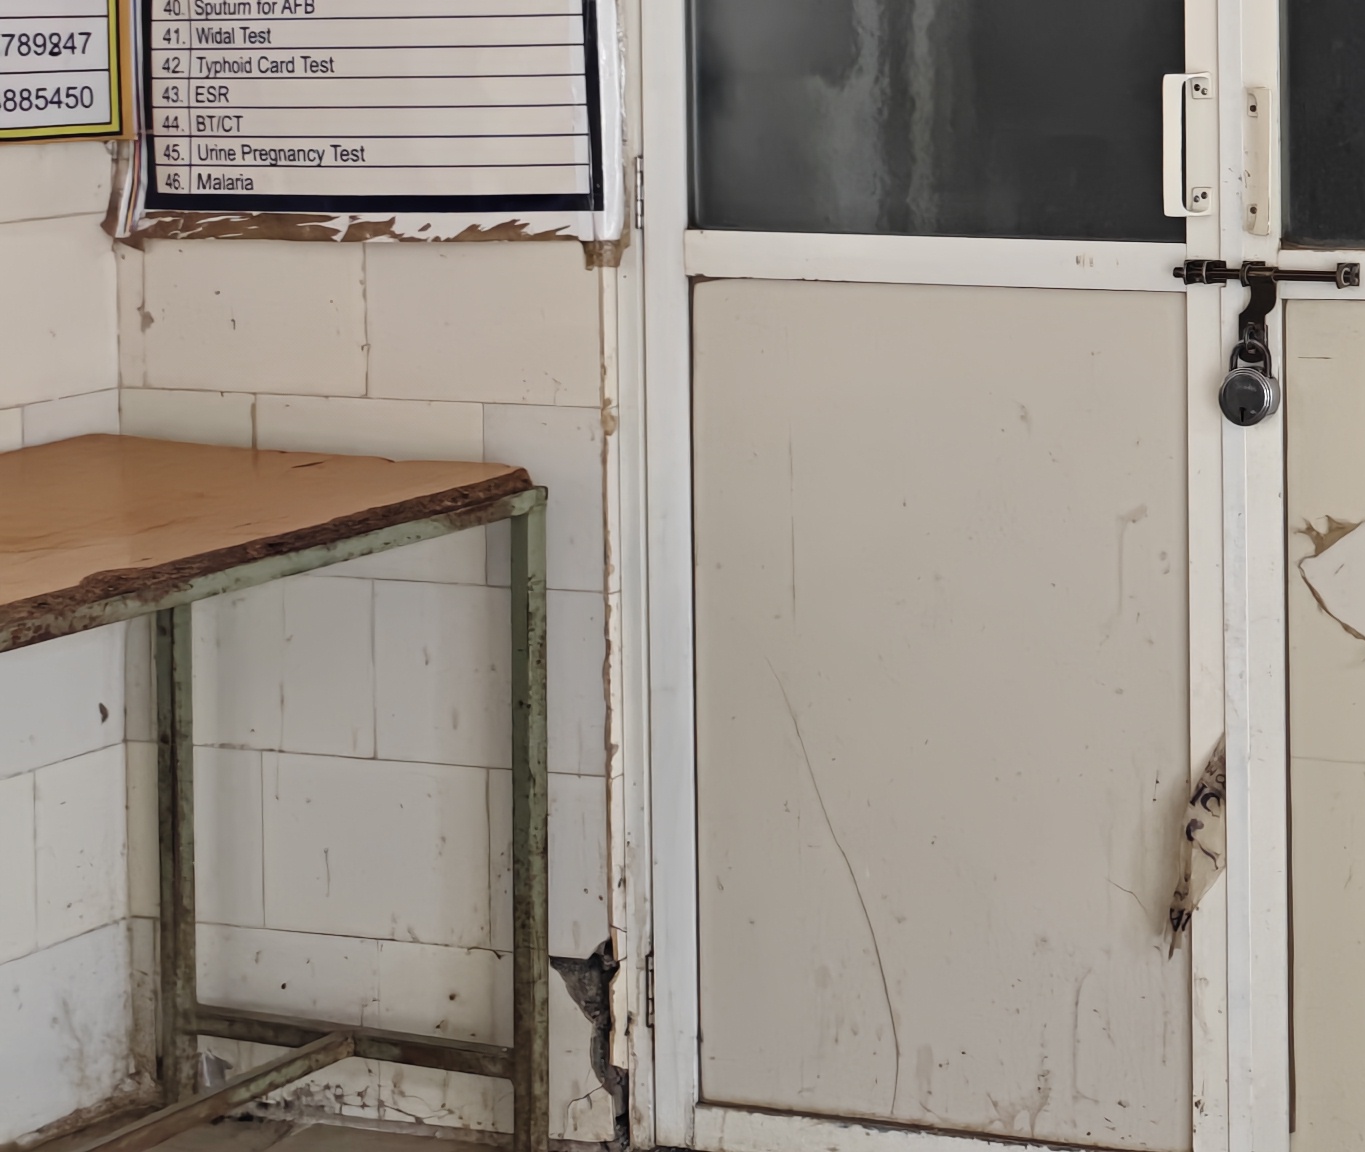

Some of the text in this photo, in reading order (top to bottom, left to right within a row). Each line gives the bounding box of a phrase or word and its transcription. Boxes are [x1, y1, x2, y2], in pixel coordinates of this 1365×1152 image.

[196, 27, 272, 45] Widal Test
[196, 56, 335, 78] Typhoid Card Test
[195, 86, 230, 104] ESR
[195, 115, 243, 133] BT/CT
[197, 173, 254, 191] Malaria
